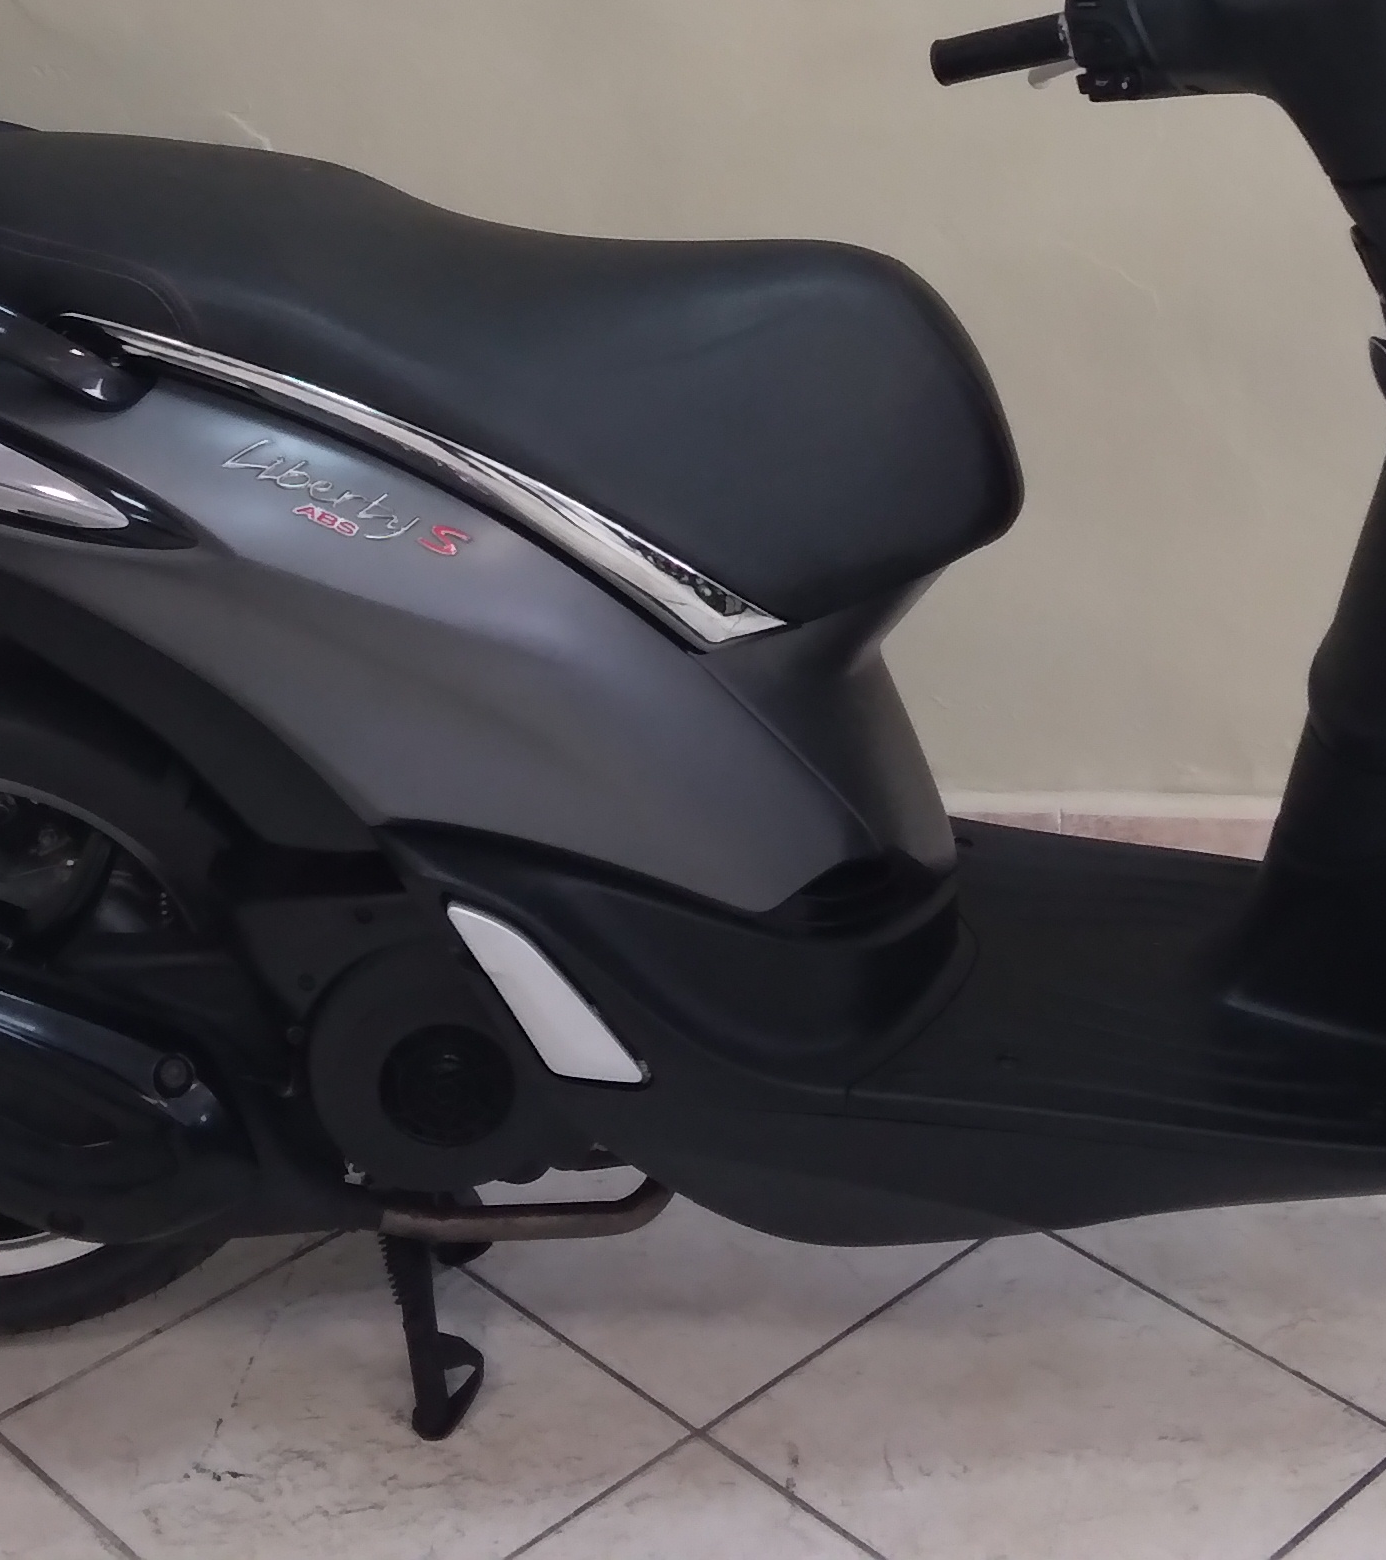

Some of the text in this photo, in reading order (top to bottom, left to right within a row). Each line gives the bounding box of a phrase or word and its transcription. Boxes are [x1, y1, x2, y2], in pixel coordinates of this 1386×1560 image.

[221, 438, 472, 556] Liberty S
[292, 503, 359, 537] ABS
